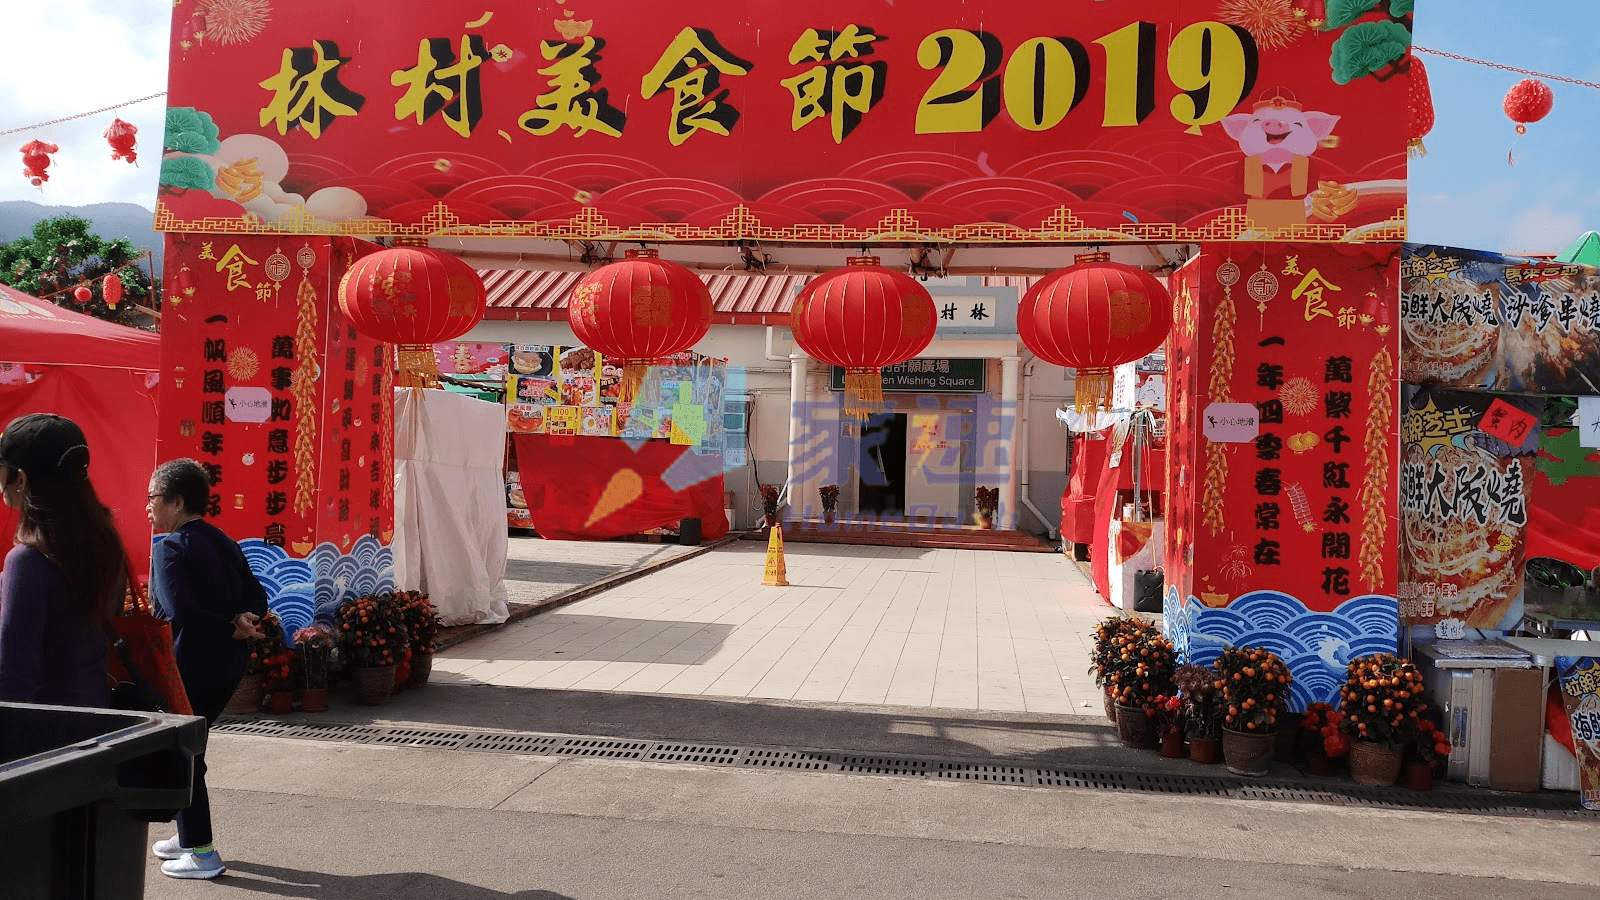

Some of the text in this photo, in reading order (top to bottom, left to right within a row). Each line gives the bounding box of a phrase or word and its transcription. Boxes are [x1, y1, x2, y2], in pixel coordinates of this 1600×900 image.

[198, 241, 272, 303] 美食節
[1281, 255, 1357, 331] 美食節
[897, 375, 936, 388] Wishing
[938, 376, 975, 388] Square
